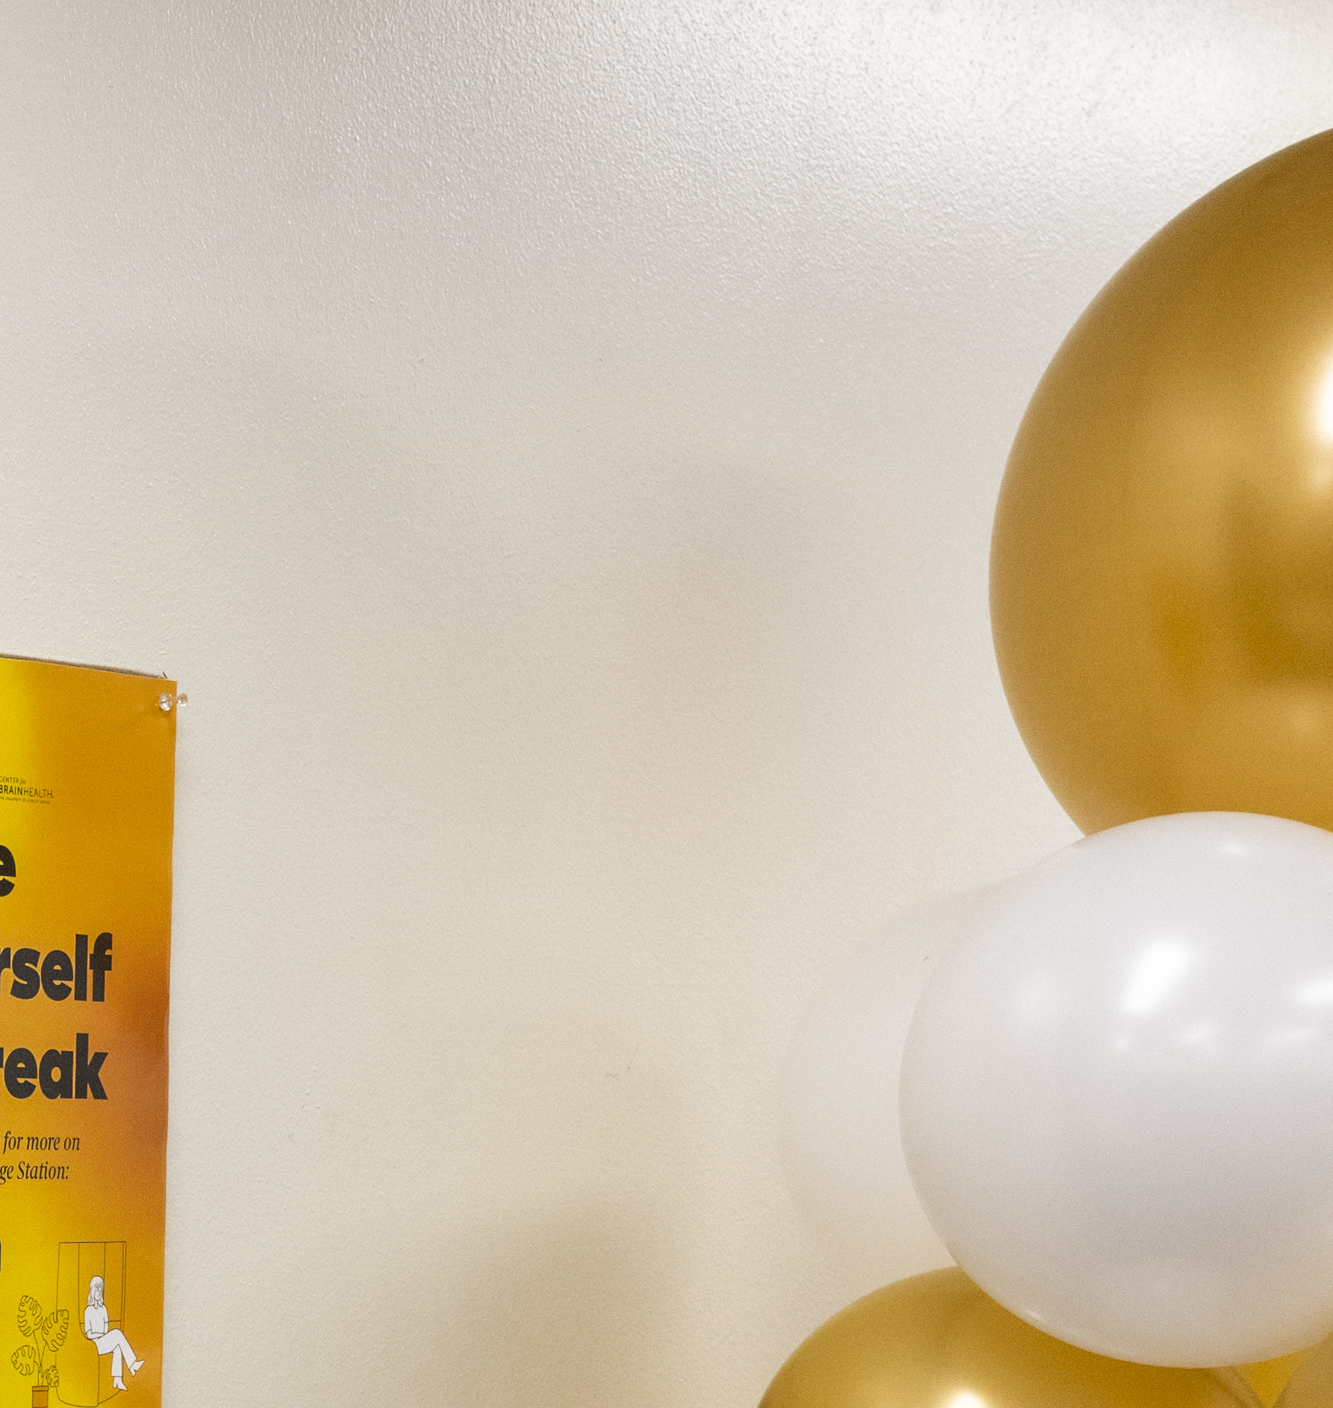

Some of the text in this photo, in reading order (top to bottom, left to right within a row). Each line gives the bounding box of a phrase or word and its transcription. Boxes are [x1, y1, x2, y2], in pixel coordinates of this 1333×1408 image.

[2, 1130, 24, 1155] for
[26, 1135, 61, 1151] more
[63, 1136, 81, 1151] on
[16, 1160, 70, 1180] Station:
